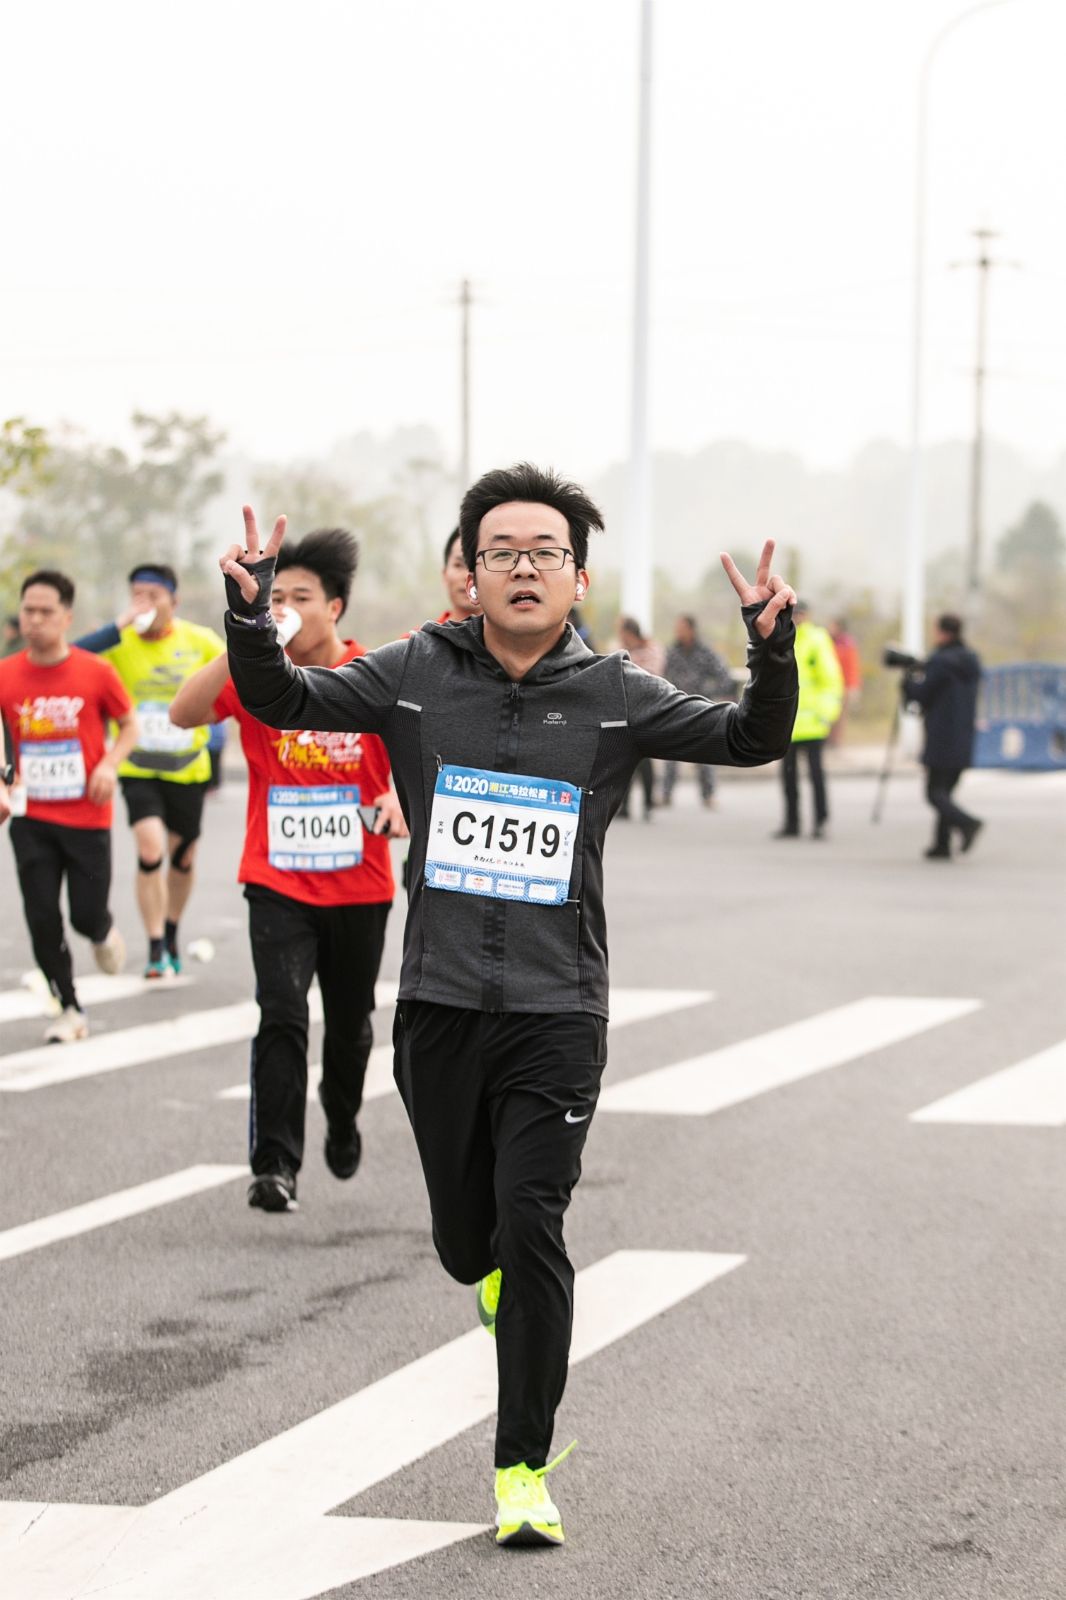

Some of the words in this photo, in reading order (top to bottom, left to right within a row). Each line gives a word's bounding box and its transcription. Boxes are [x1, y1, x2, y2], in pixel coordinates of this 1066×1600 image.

[453, 775, 489, 795] 2020
[281, 815, 351, 838] C1040
[452, 811, 560, 858] C1519
